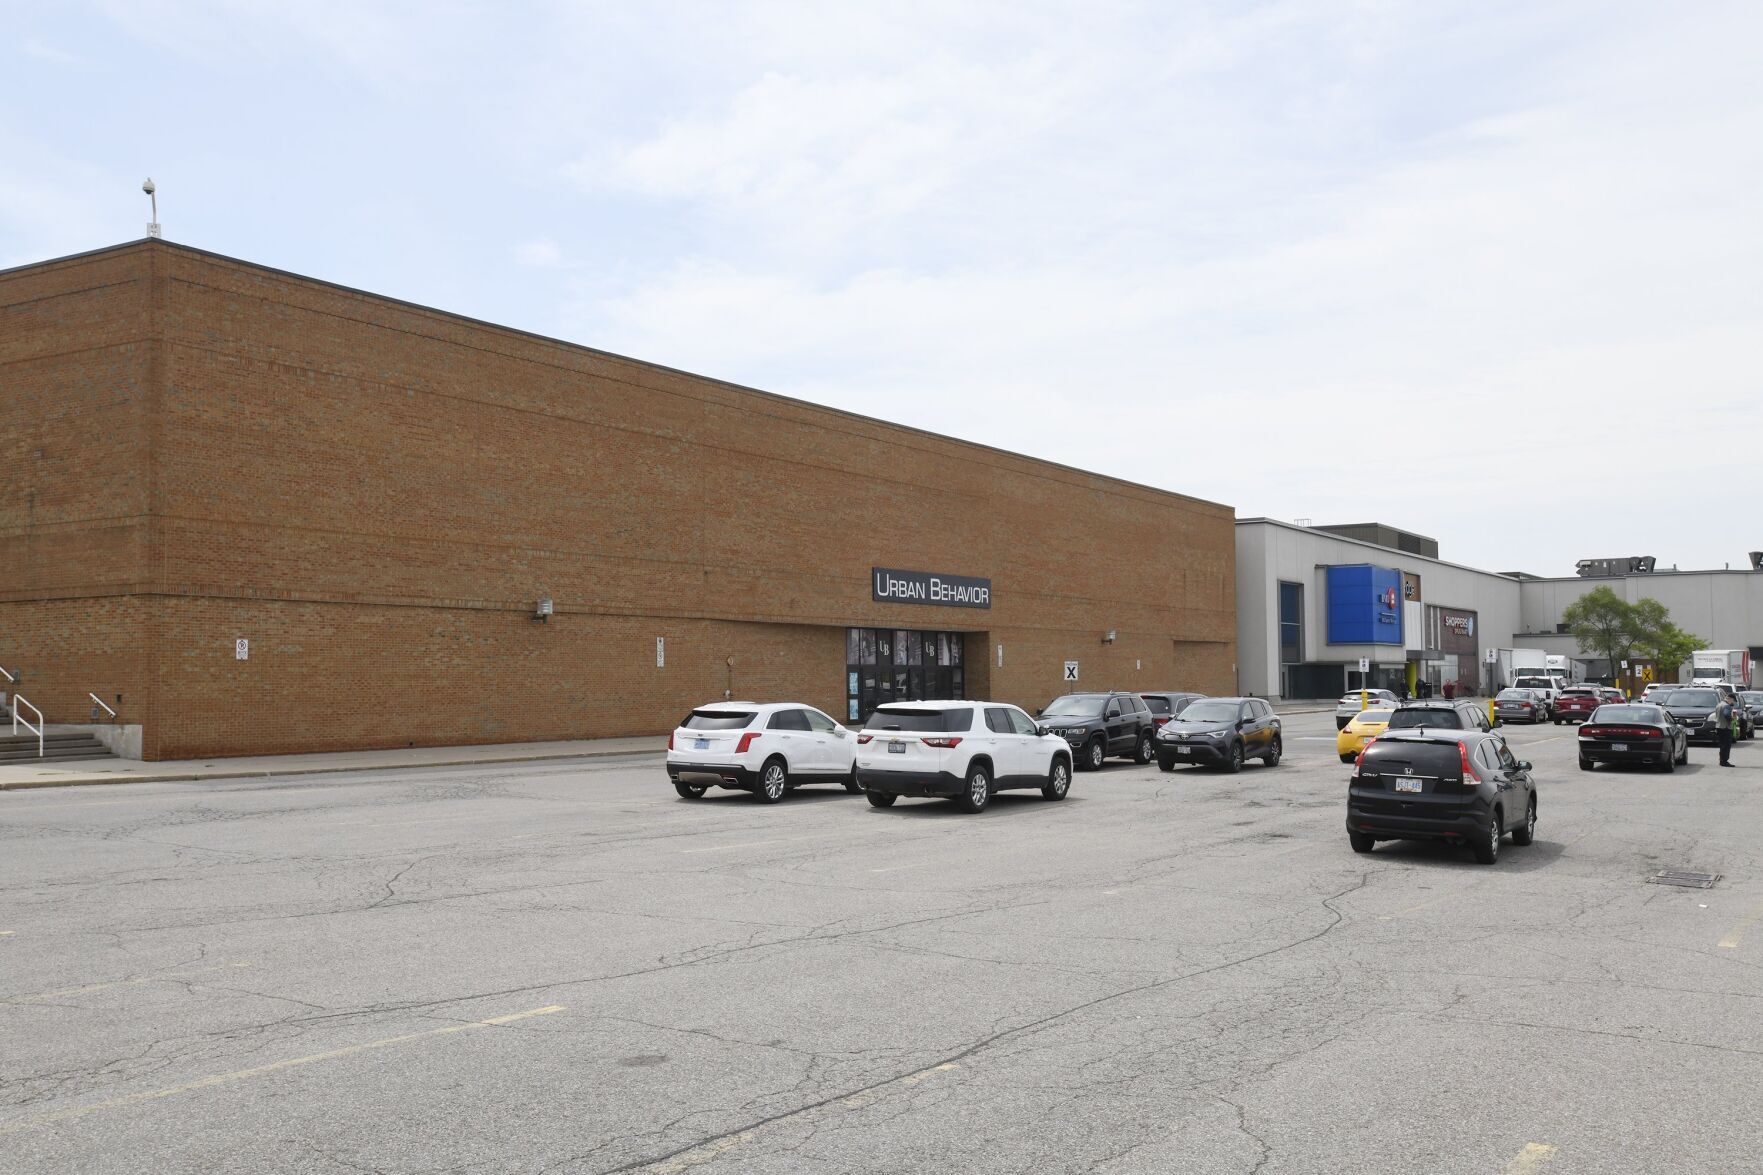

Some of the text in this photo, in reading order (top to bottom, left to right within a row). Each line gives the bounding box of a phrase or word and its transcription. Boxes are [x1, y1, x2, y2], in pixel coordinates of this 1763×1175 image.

[877, 573, 989, 604] URBAN BEHAVIOR
[1445, 615, 1468, 628] SHOPPERS
[1066, 666, 1076, 679] X
